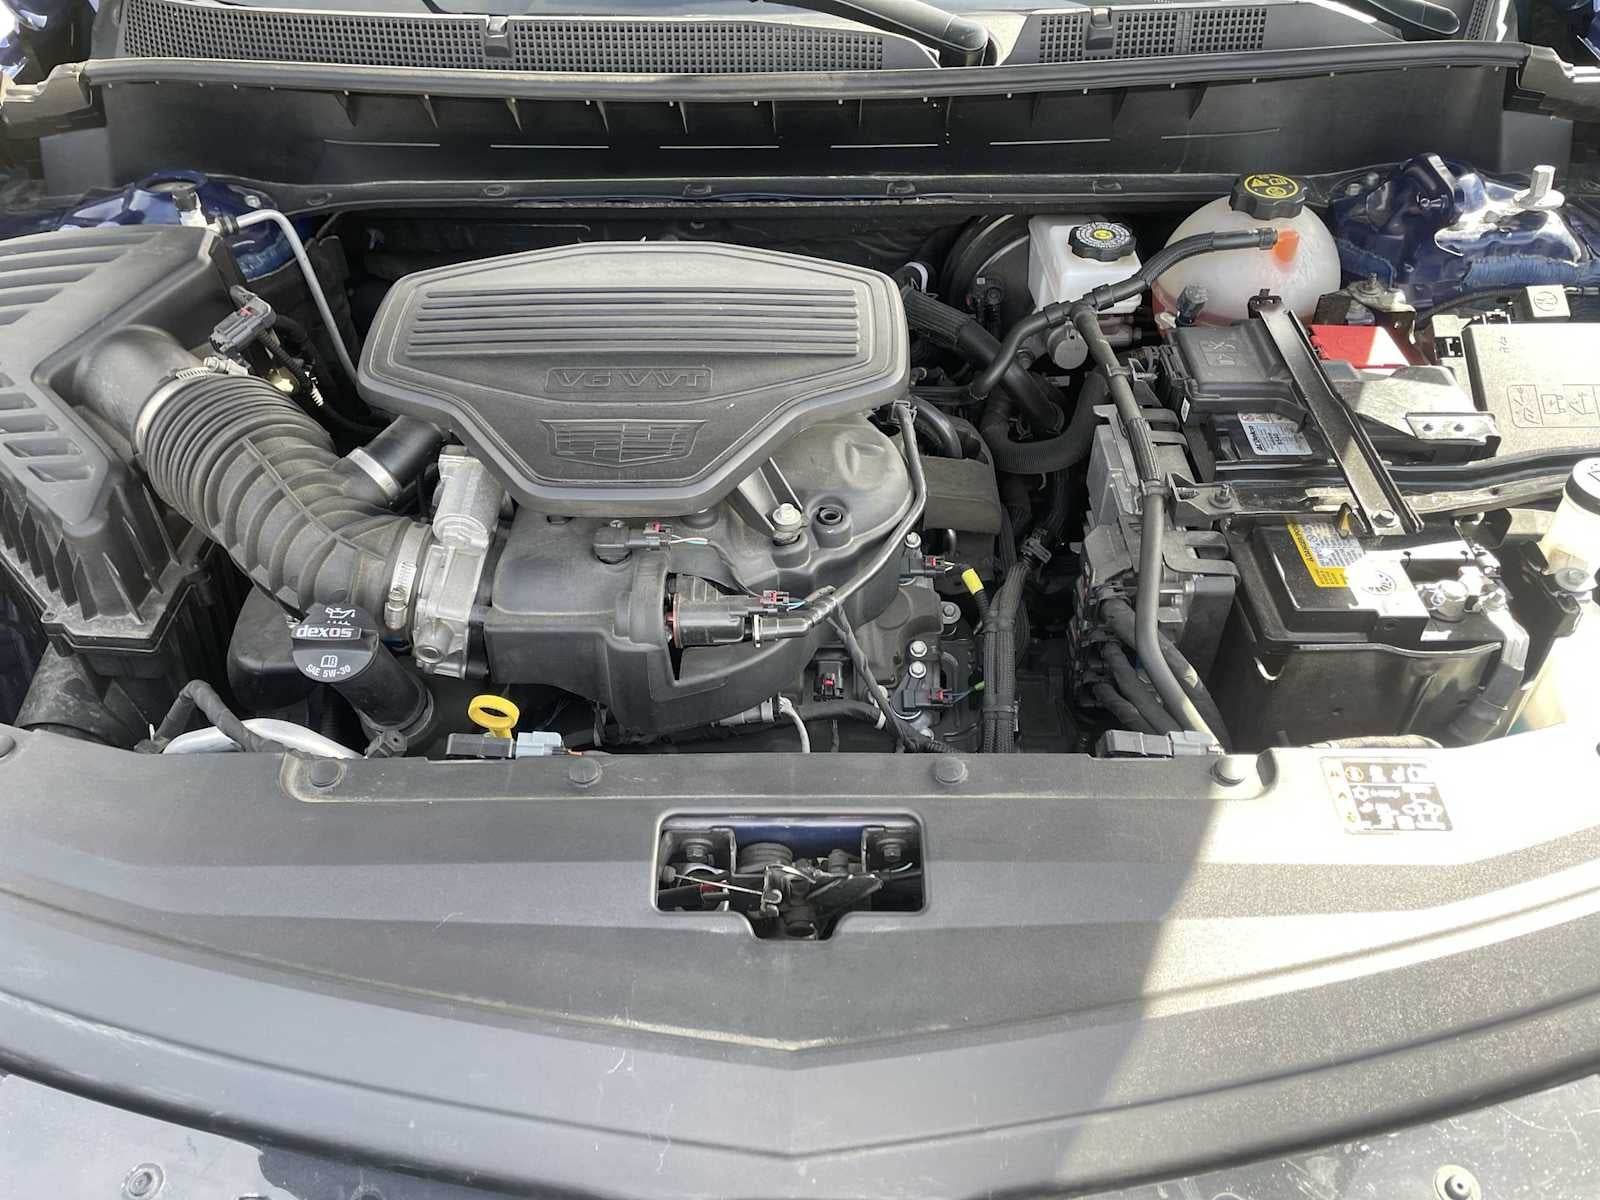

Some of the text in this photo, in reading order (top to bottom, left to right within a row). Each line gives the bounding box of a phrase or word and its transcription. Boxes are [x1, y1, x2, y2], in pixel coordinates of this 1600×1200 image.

[553, 369, 707, 387] V6 VVT
[296, 625, 354, 638] dexos
[305, 664, 351, 678] SAE 5W-30
